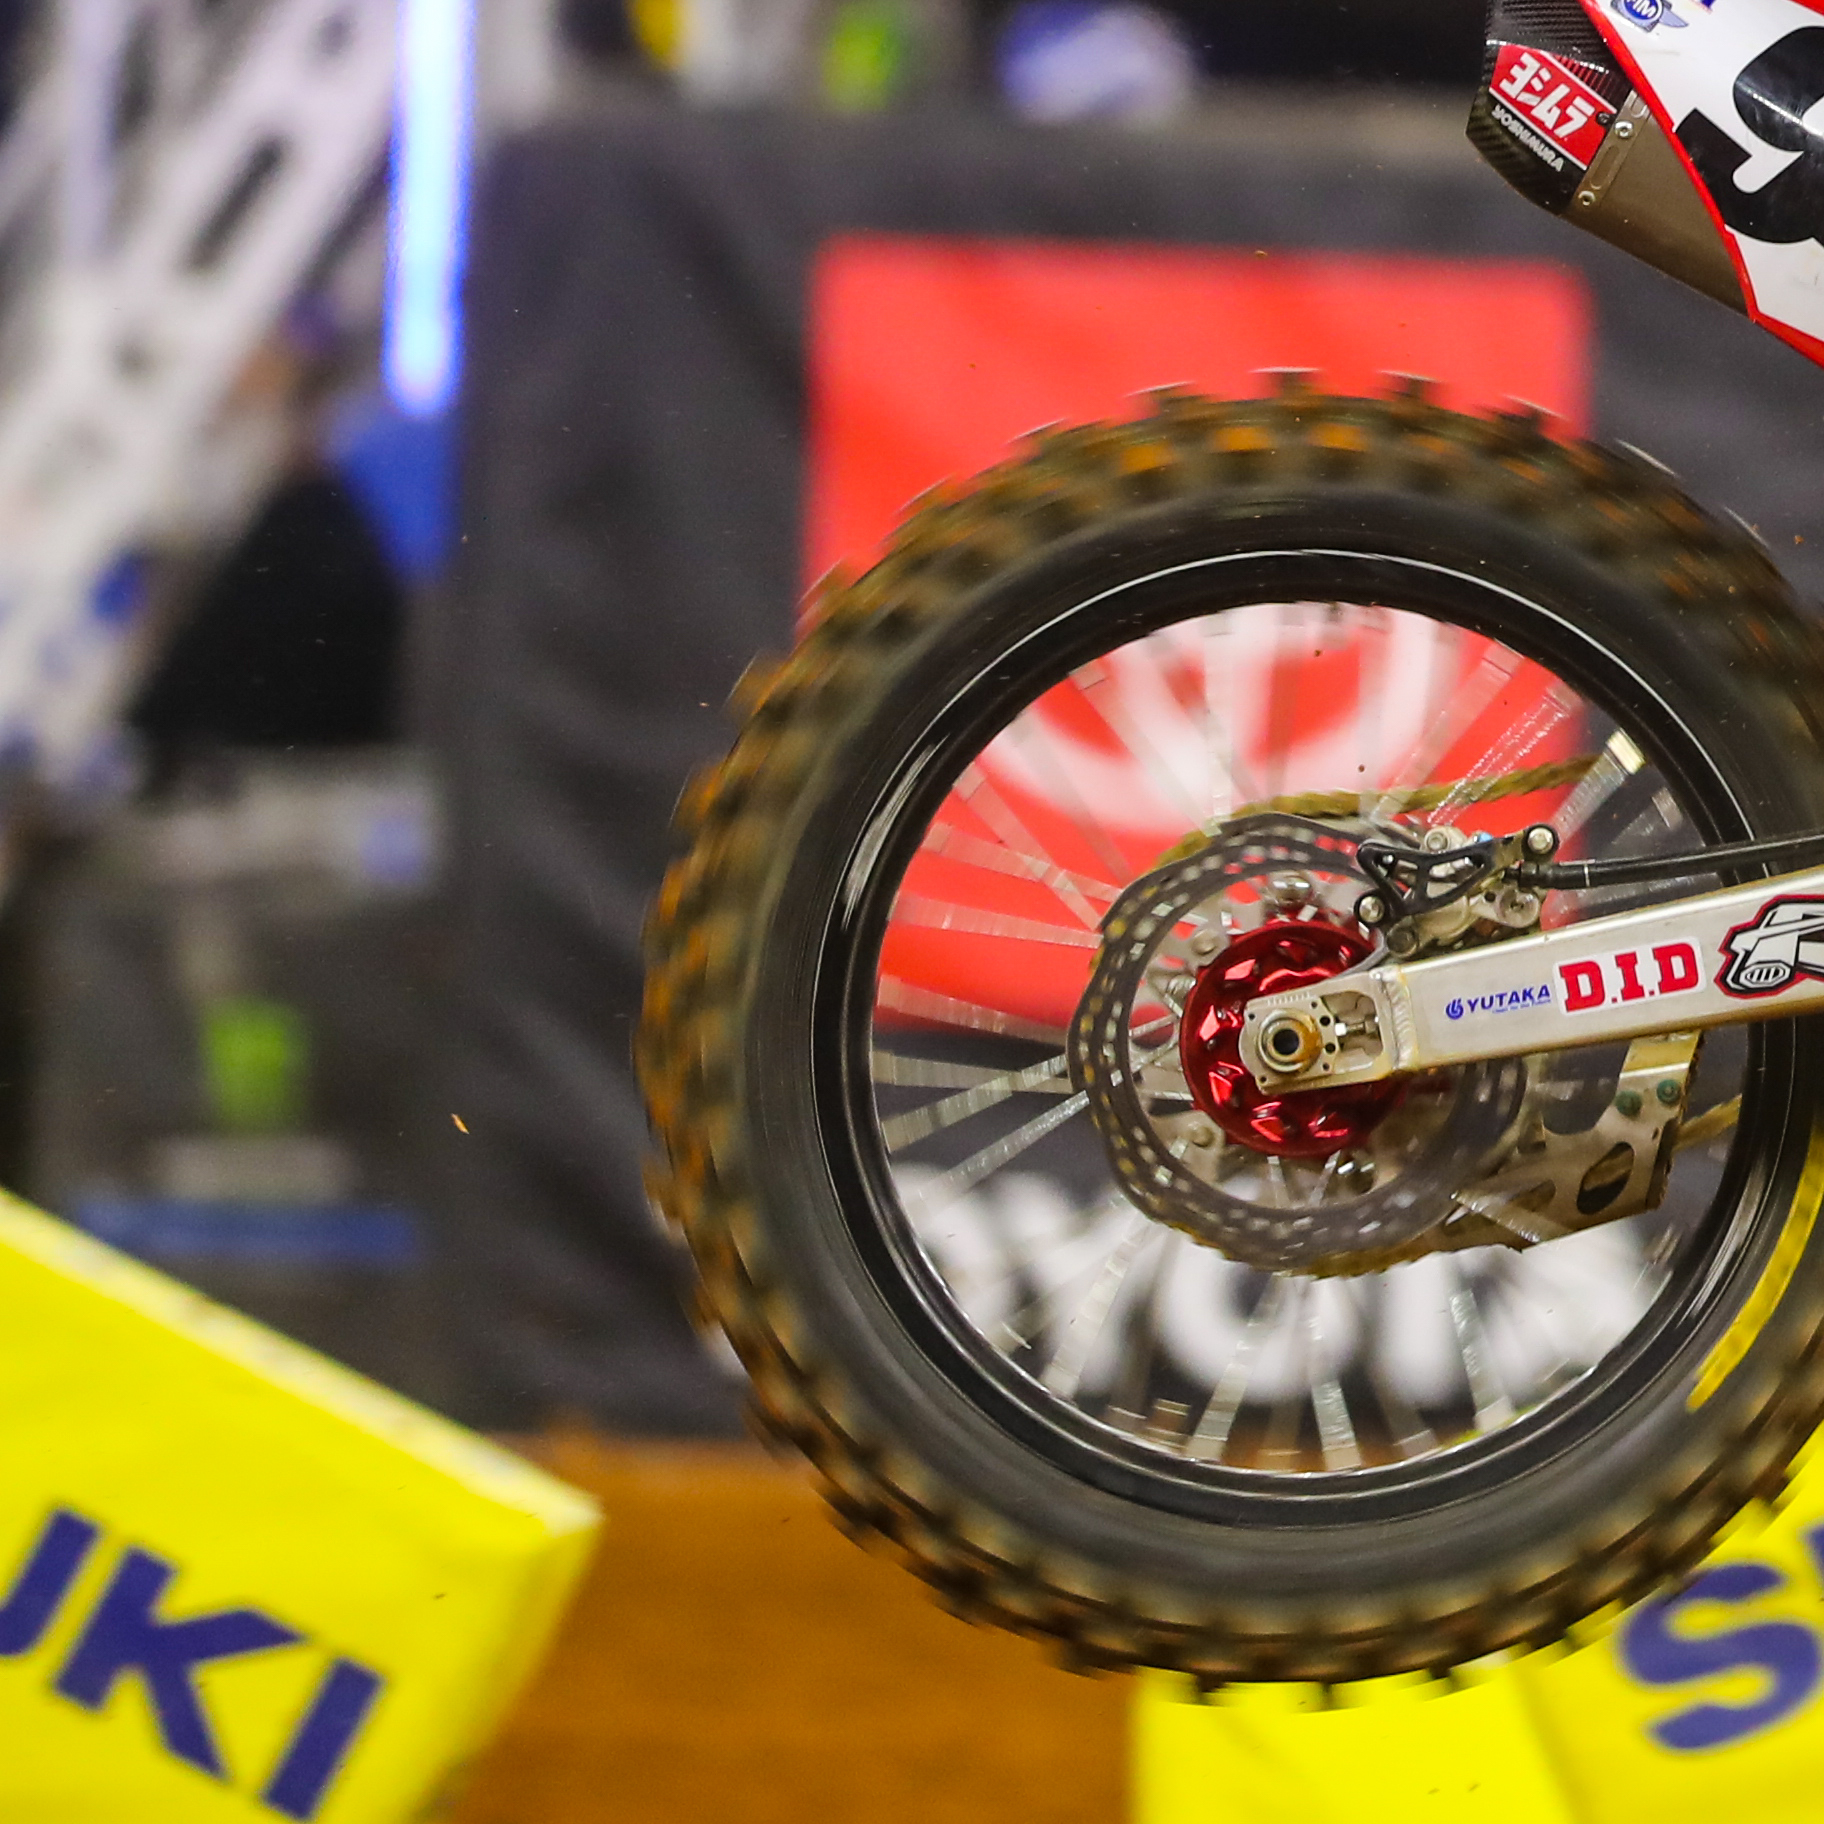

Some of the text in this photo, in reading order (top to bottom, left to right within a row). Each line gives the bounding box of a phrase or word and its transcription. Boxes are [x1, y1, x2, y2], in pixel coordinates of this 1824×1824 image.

[1499, 51, 1596, 139] ヨシムラ
[1491, 103, 1565, 173] YOSHIMURA
[1467, 984, 1551, 1013] YUTAKA
[1558, 941, 1700, 1012] D.I.D
